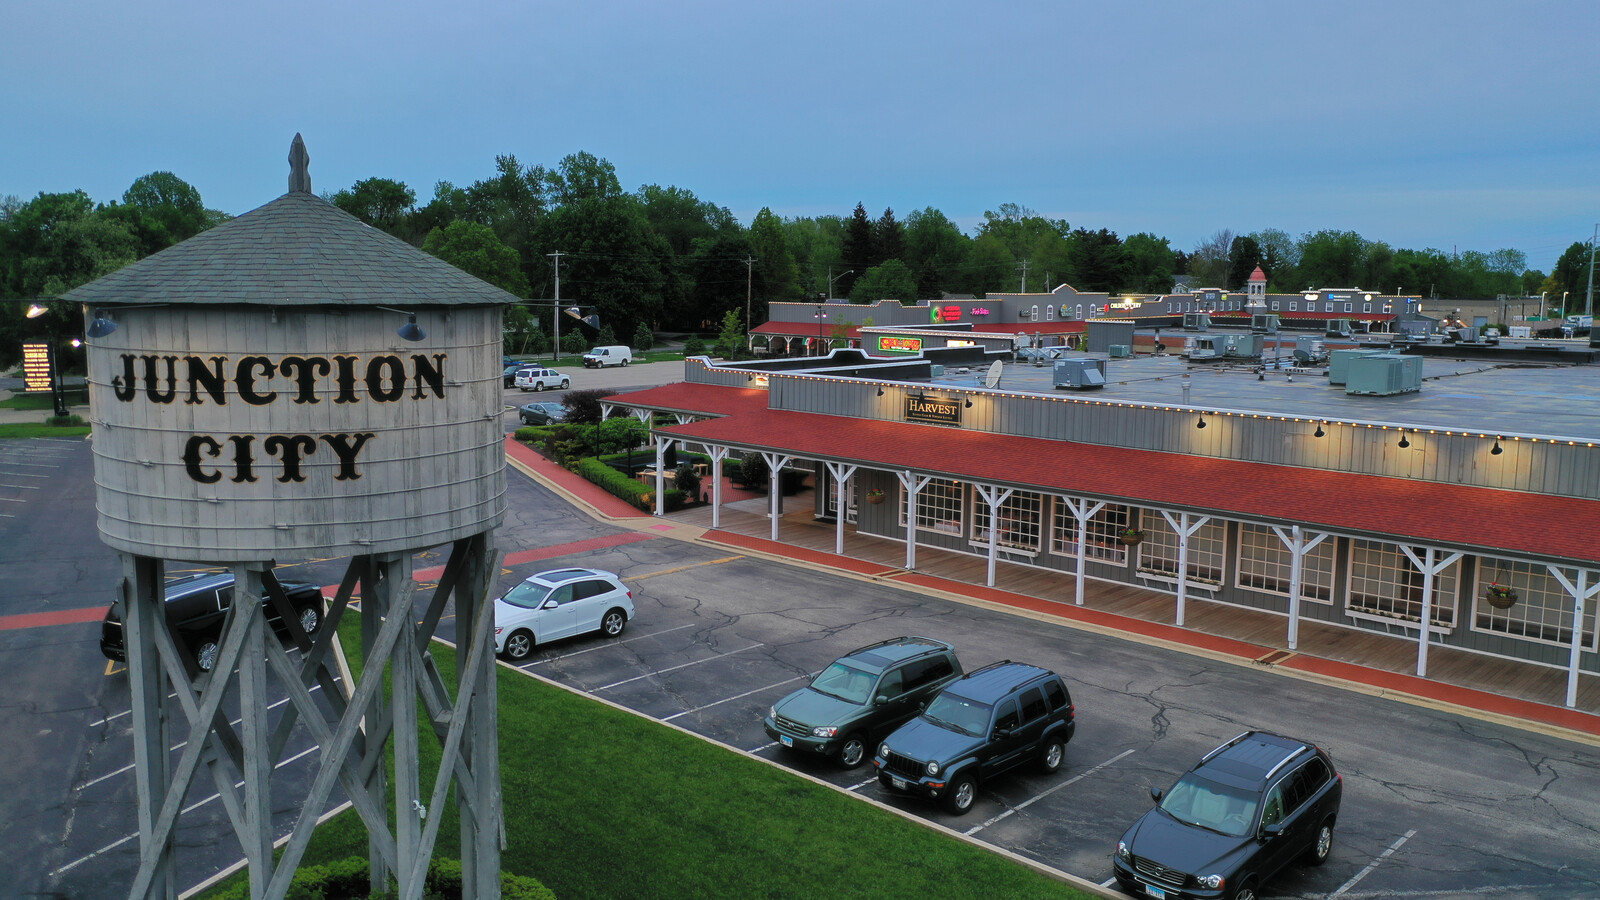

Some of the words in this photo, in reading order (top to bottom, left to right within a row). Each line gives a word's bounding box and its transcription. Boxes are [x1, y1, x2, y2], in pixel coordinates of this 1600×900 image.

[111, 353, 448, 406] JUNCTION
[909, 399, 957, 415] HARVEST
[182, 432, 378, 484] CITY
